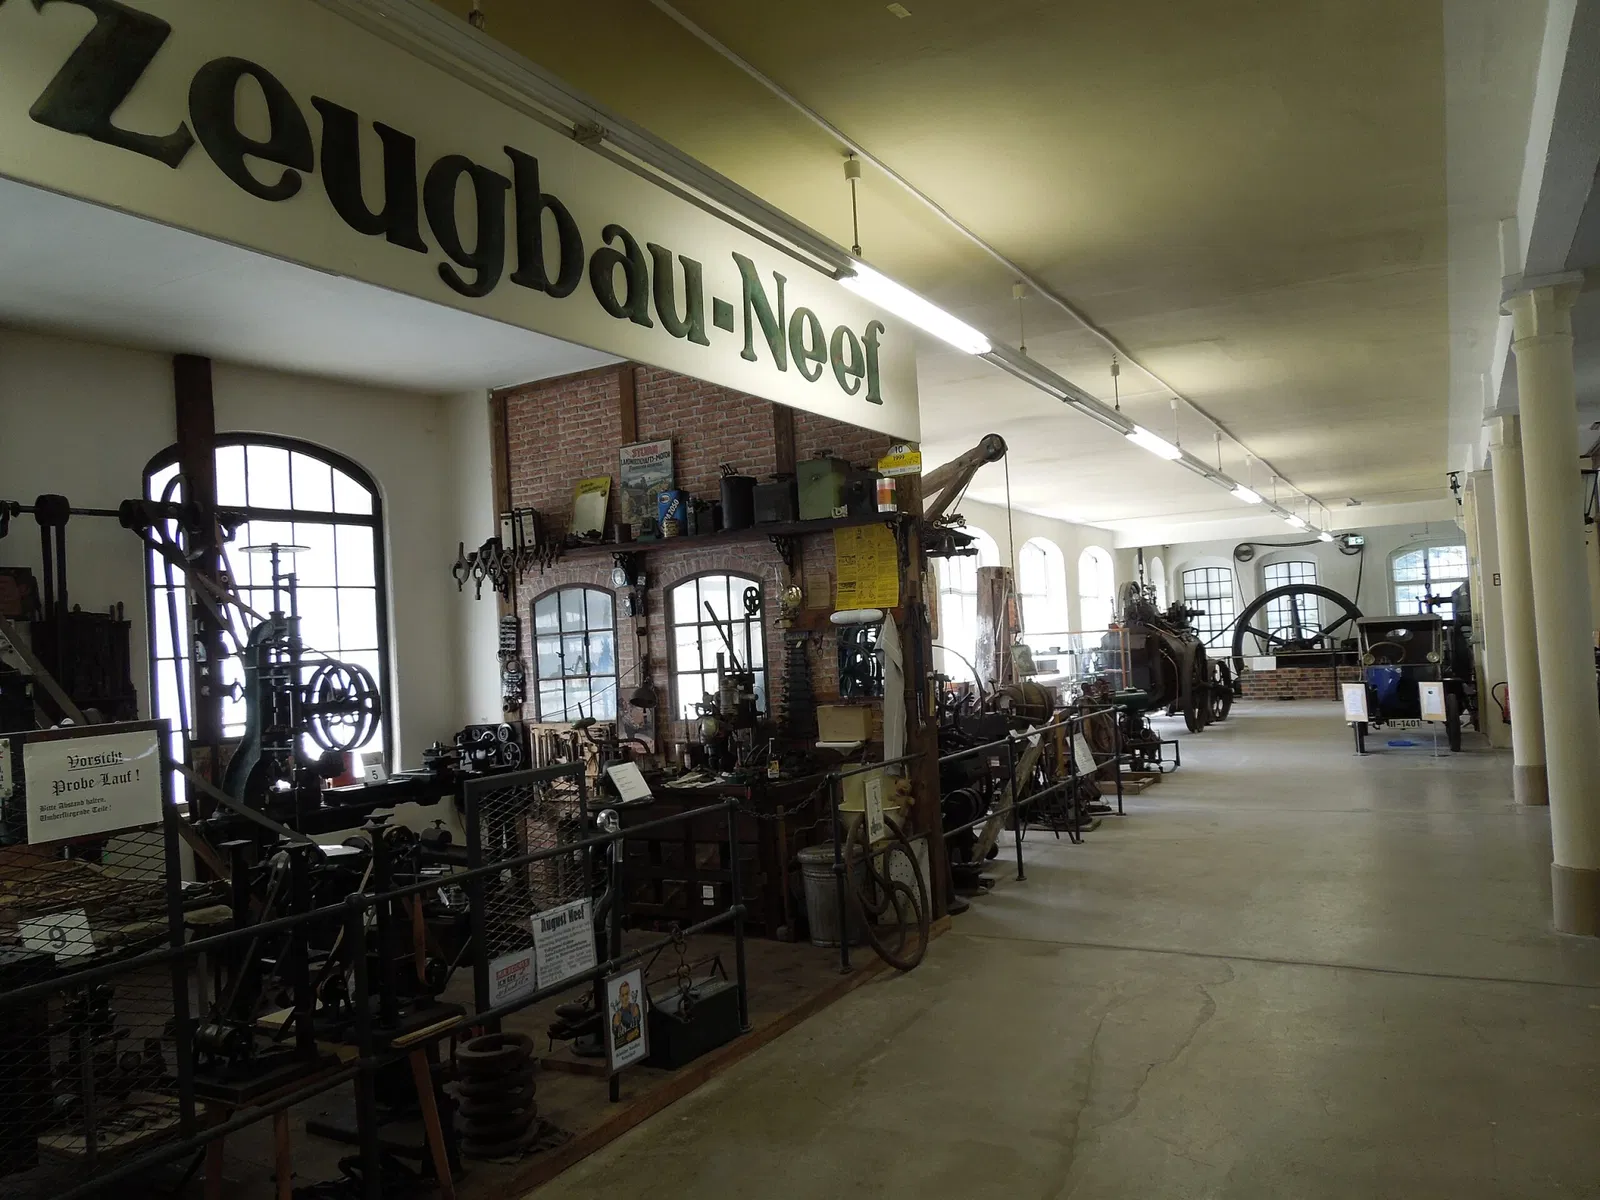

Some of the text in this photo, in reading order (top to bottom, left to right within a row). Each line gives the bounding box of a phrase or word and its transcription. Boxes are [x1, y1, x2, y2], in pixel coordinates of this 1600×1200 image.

[67, 751, 123, 768] Vorsicht
[372, 770, 379, 780] 5
[52, 776, 95, 796] Probe
[540, 912, 567, 933] August
[48, 927, 67, 949] 9
